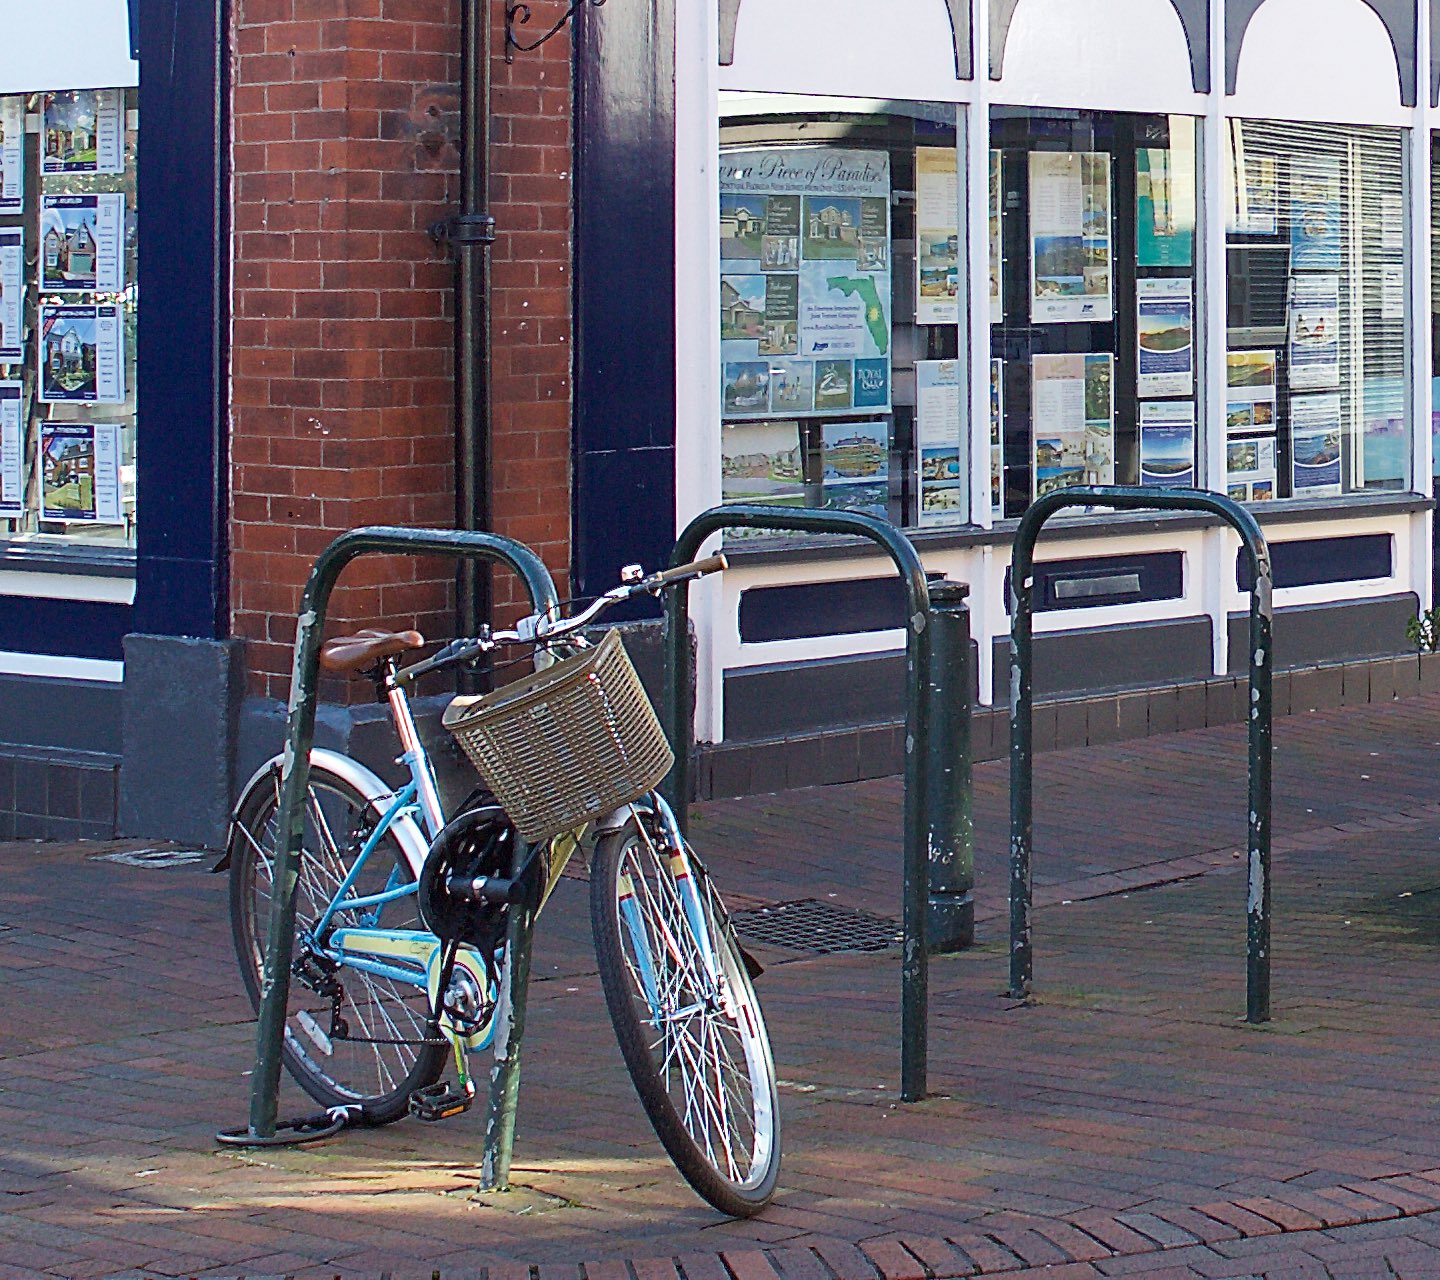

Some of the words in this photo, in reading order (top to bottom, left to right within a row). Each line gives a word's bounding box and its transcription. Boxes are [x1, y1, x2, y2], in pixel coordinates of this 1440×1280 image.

[759, 153, 803, 180] Piece
[805, 159, 820, 184] of
[821, 154, 887, 183] Paradise!
